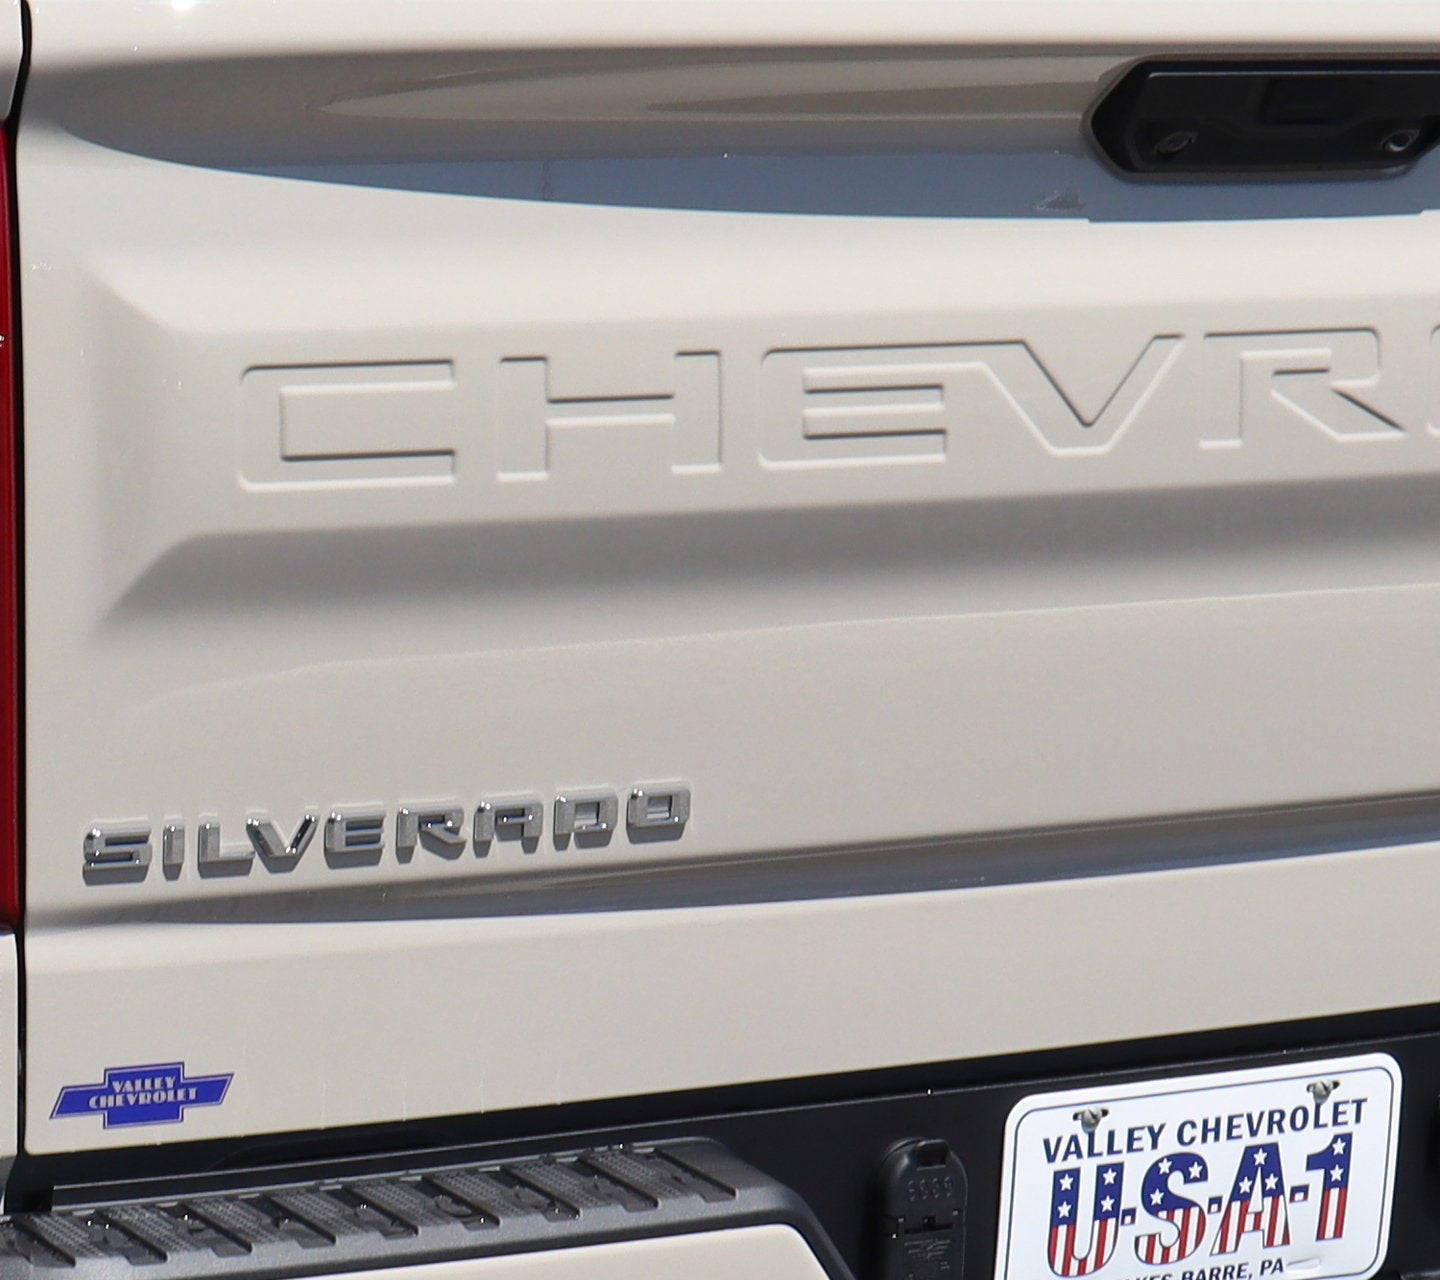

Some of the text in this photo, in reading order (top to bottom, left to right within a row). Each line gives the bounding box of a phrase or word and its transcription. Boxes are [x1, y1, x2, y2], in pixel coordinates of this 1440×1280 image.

[83, 786, 692, 886] SILVERADO
[112, 1076, 176, 1093] VALLEY
[88, 1087, 198, 1109] CHEVROLET
[1042, 1097, 1368, 1164] VALLEY CHEVROLET
[1259, 1258, 1284, 1276] PA
